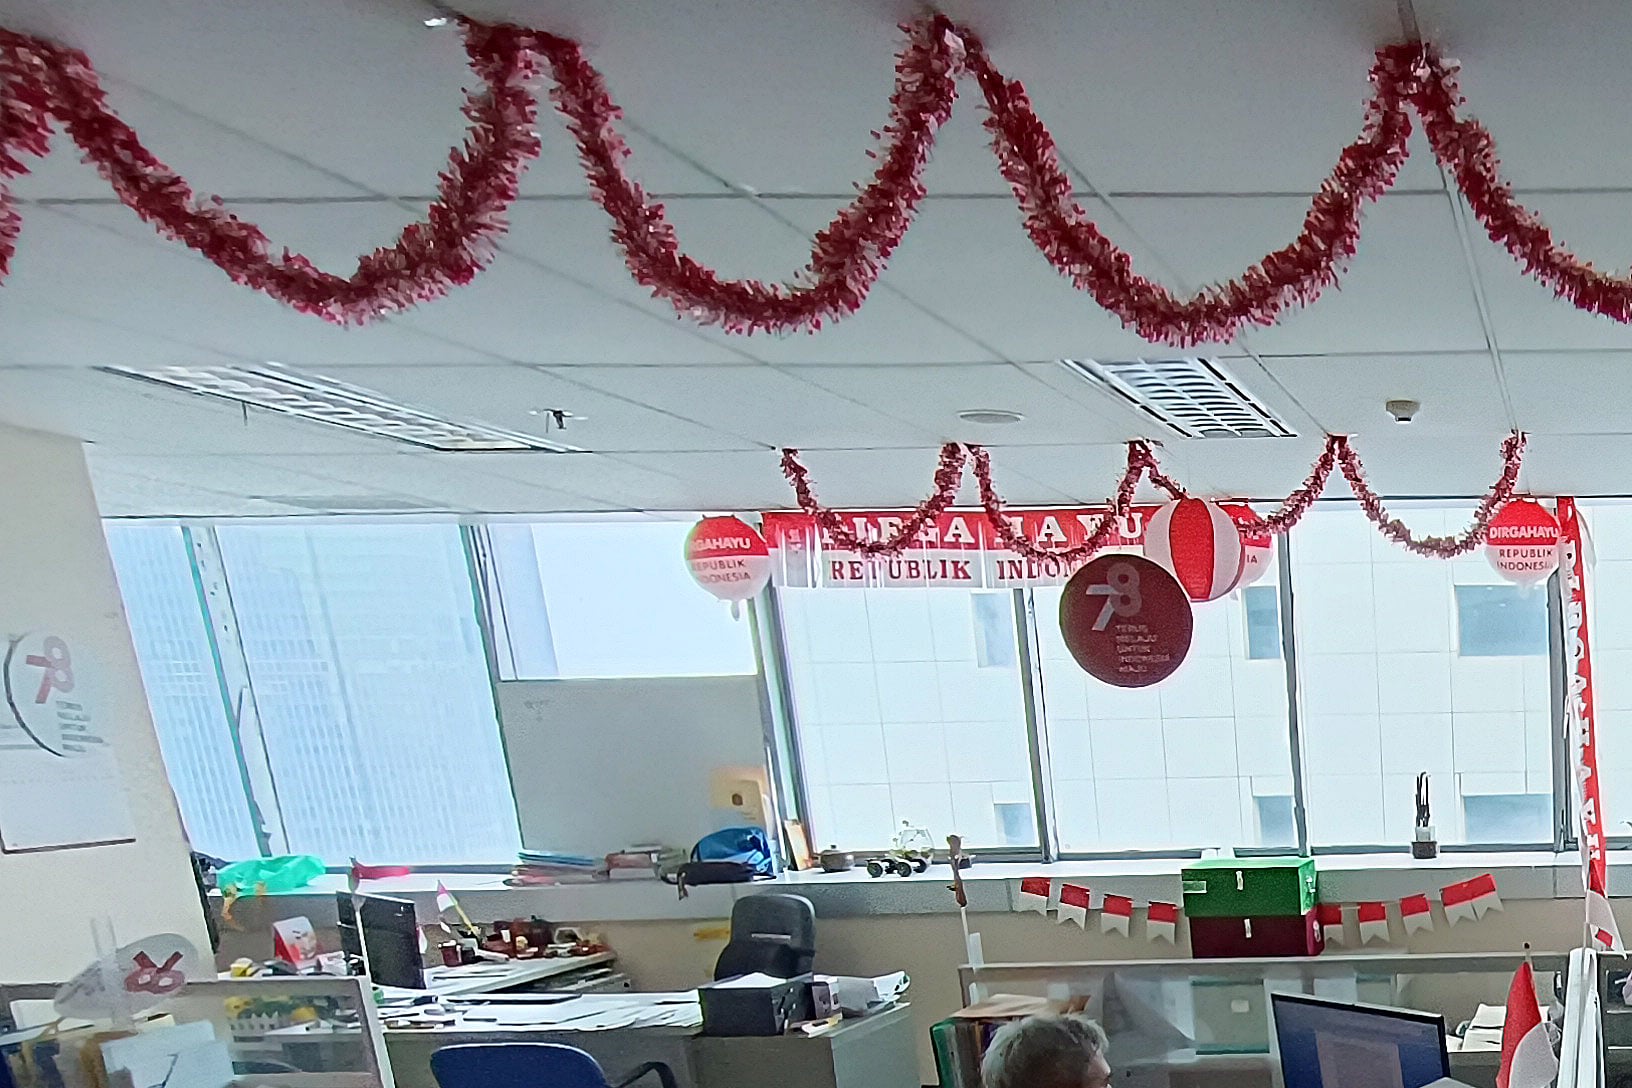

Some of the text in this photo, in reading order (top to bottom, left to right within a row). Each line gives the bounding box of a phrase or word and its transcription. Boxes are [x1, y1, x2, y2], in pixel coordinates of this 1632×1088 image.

[1489, 525, 1559, 539] DIRGAHAYU
[1499, 548, 1553, 559] REPUBLIK
[1086, 561, 1142, 631] 78
